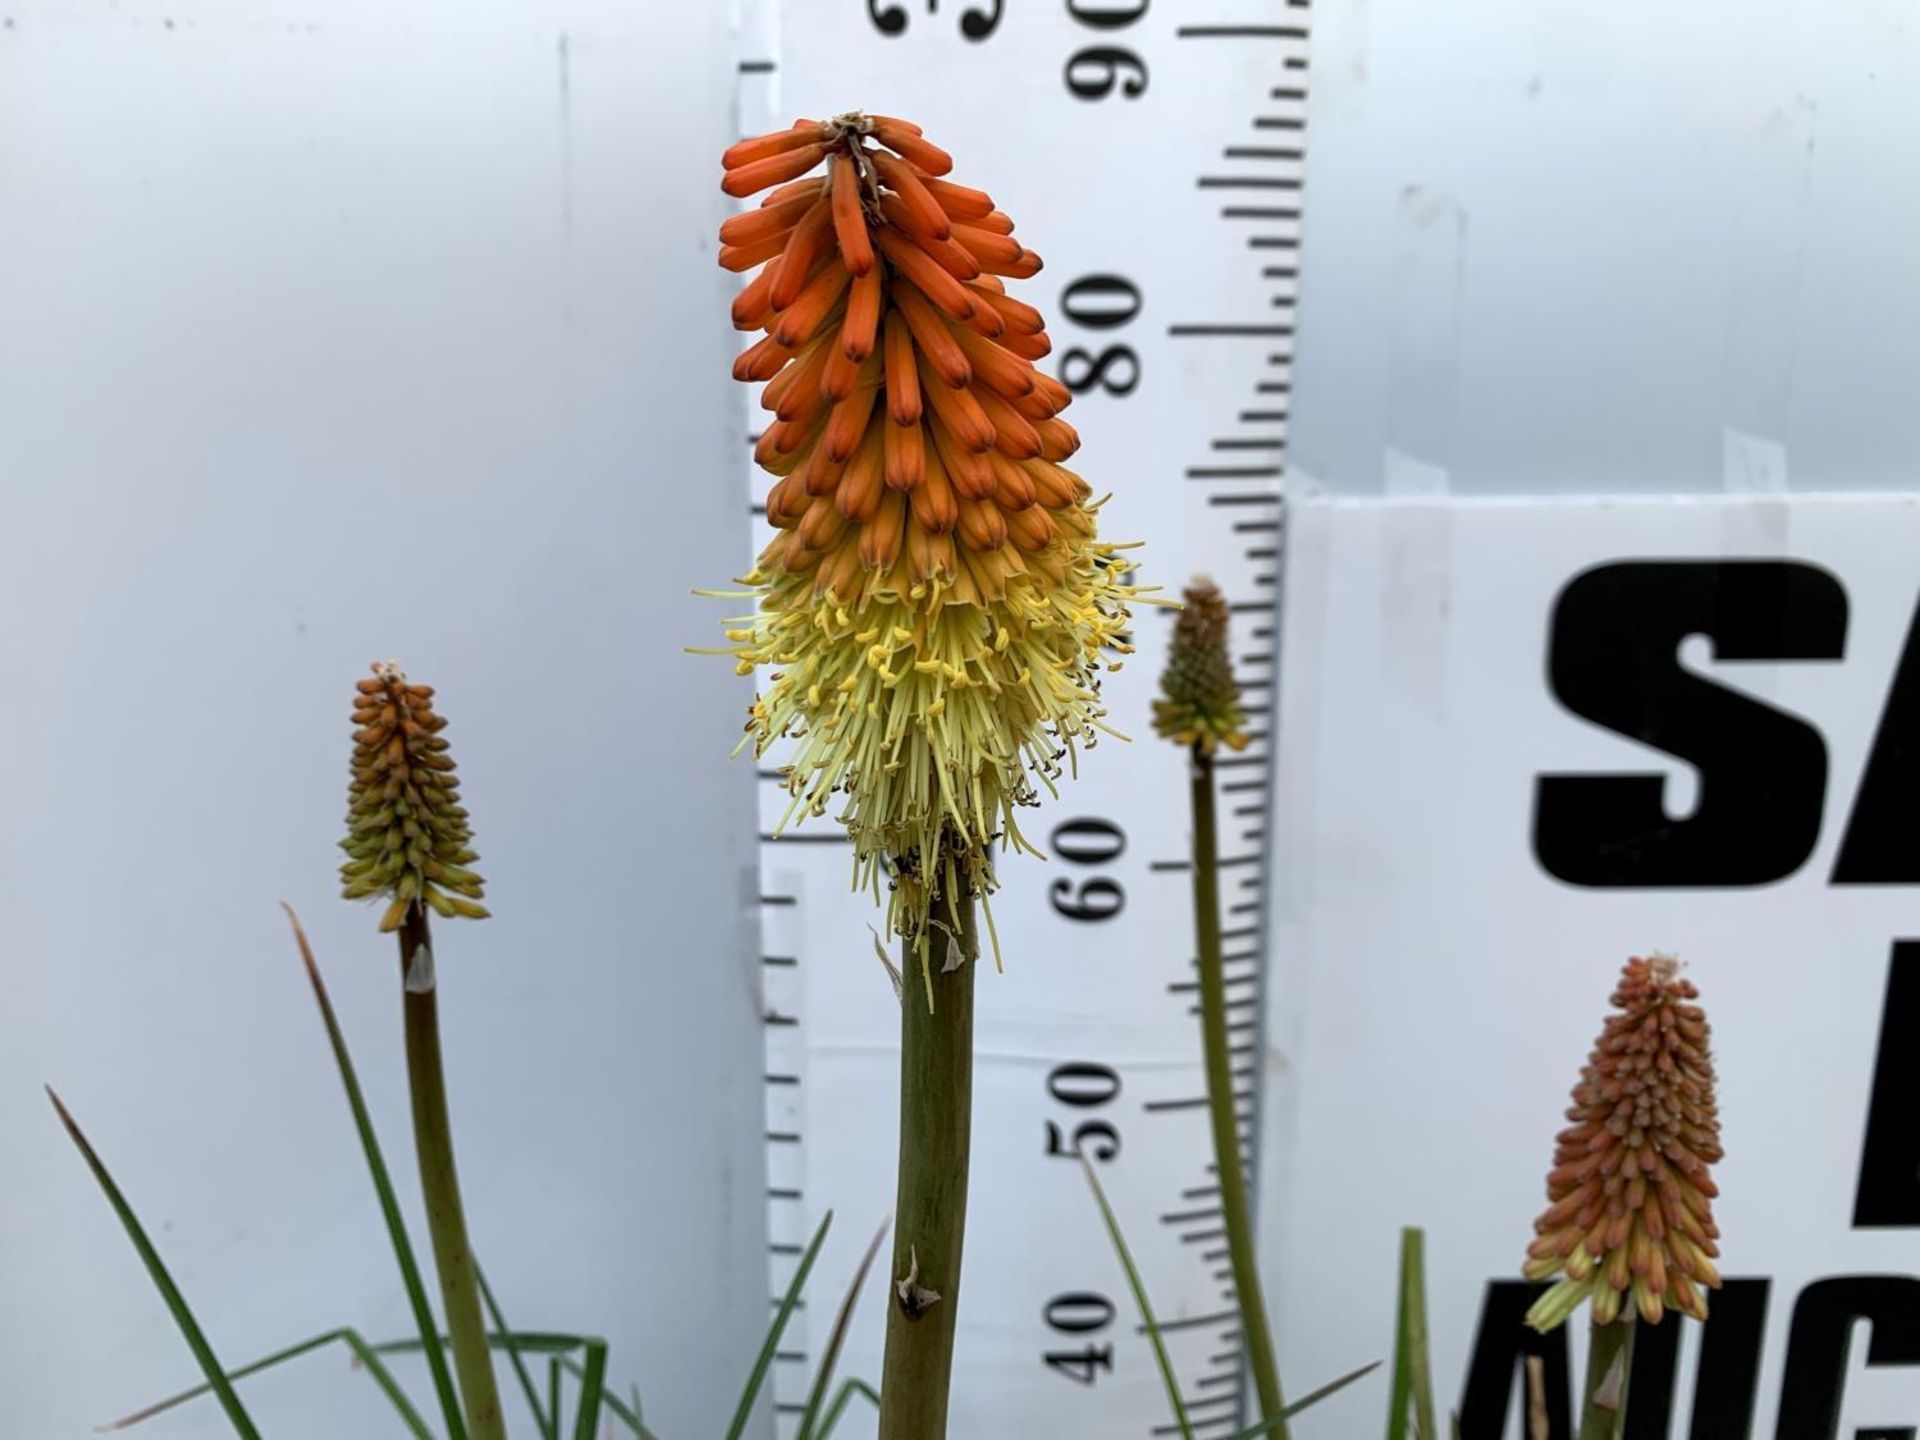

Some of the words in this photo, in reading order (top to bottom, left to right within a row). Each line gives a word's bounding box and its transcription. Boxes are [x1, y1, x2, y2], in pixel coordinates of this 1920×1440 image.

[1056, 272, 1142, 398] 80
[1531, 558, 1920, 889] S
[1049, 816, 1126, 924] 60
[1045, 1060, 1121, 1163] 50
[1042, 1290, 1117, 1387] 40
